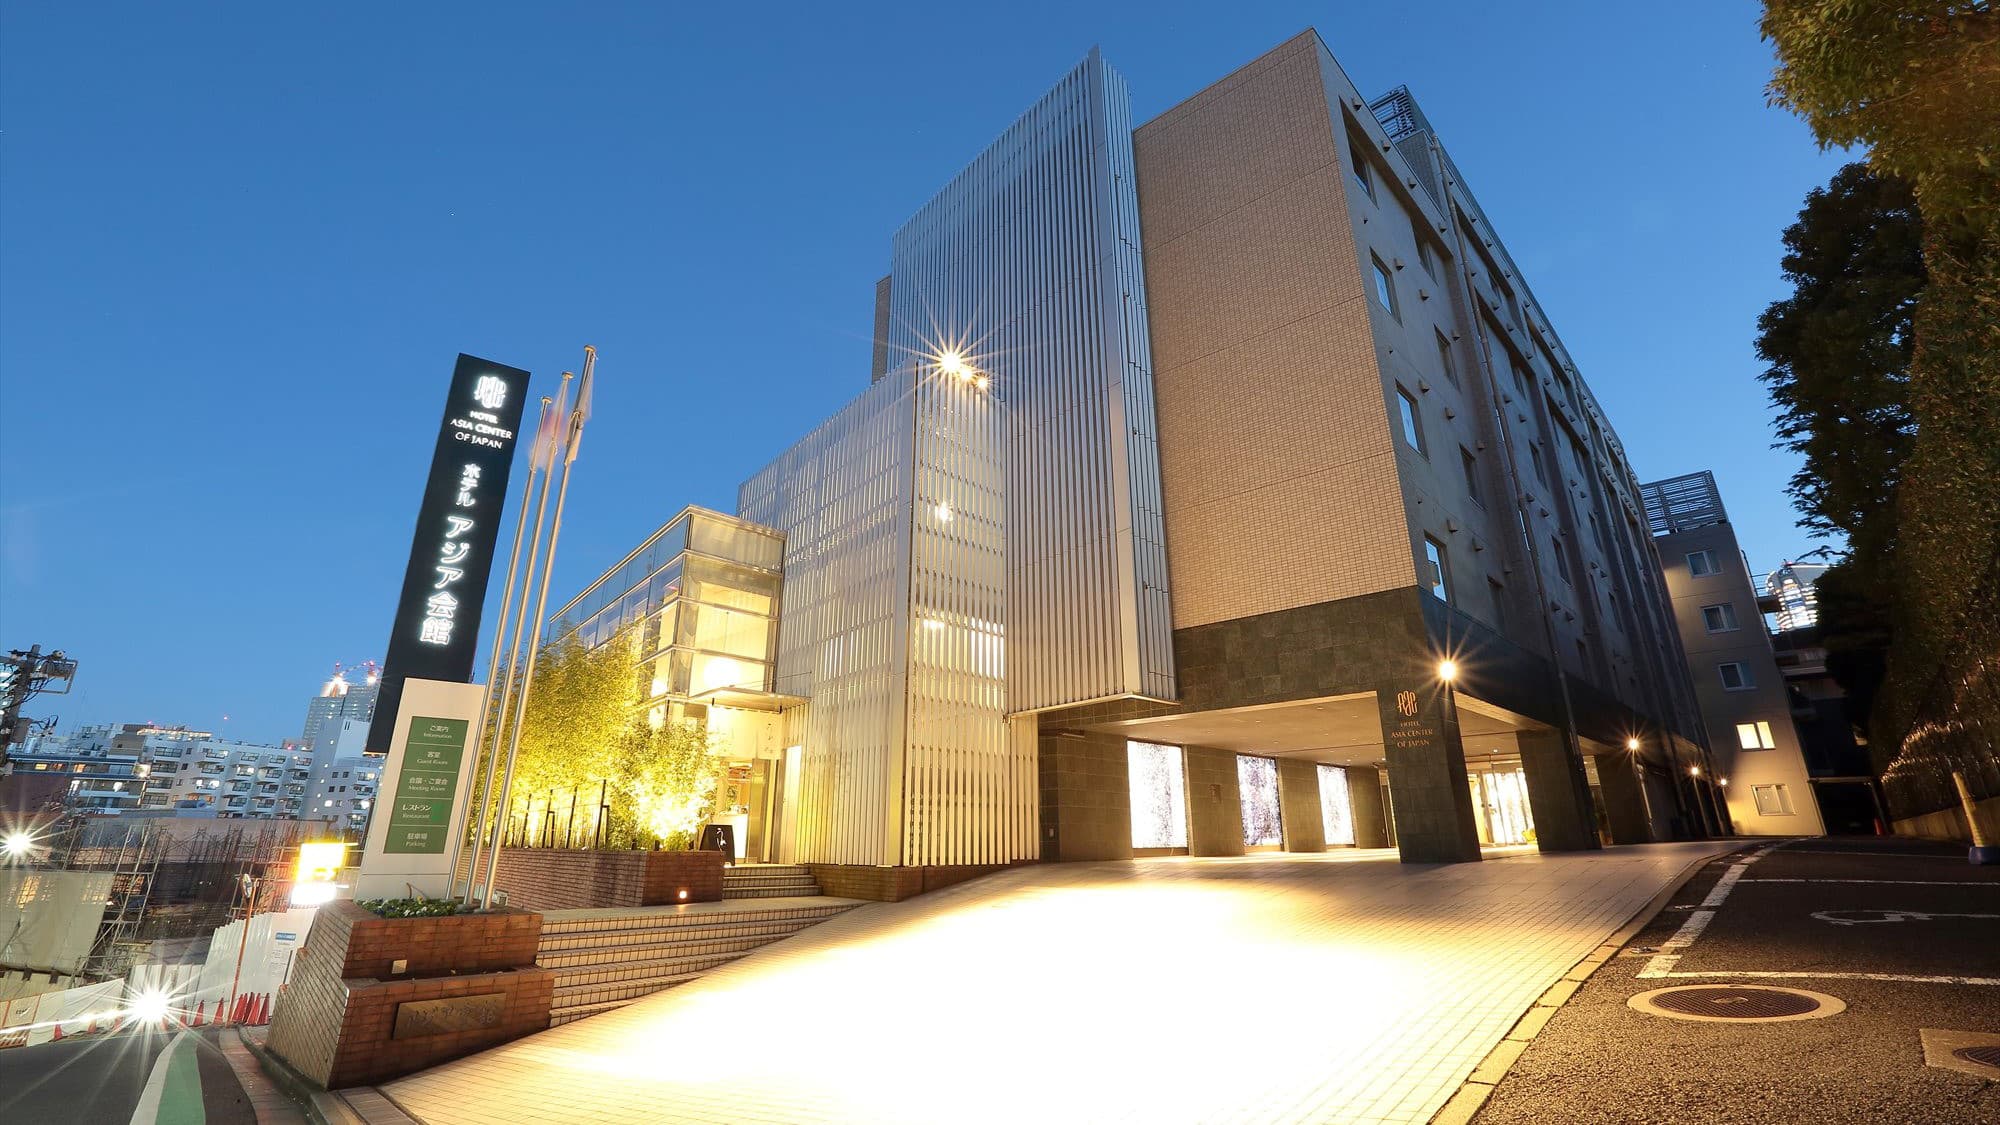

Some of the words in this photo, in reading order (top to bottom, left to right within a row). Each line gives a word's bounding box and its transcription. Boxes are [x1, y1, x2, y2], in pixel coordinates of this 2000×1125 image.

[470, 410, 498, 424] HOTEL
[450, 418, 473, 431] ASIA
[475, 423, 512, 439] CENTER
[455, 431, 470, 441] OF
[471, 434, 503, 449] JAPAN
[456, 463, 481, 506] ホテル
[419, 515, 474, 646] アジア会館
[1391, 731, 1406, 739] ASIA
[1407, 729, 1433, 738] CENTER
[1397, 741, 1406, 749] OF
[1408, 739, 1430, 748] JAPAN
